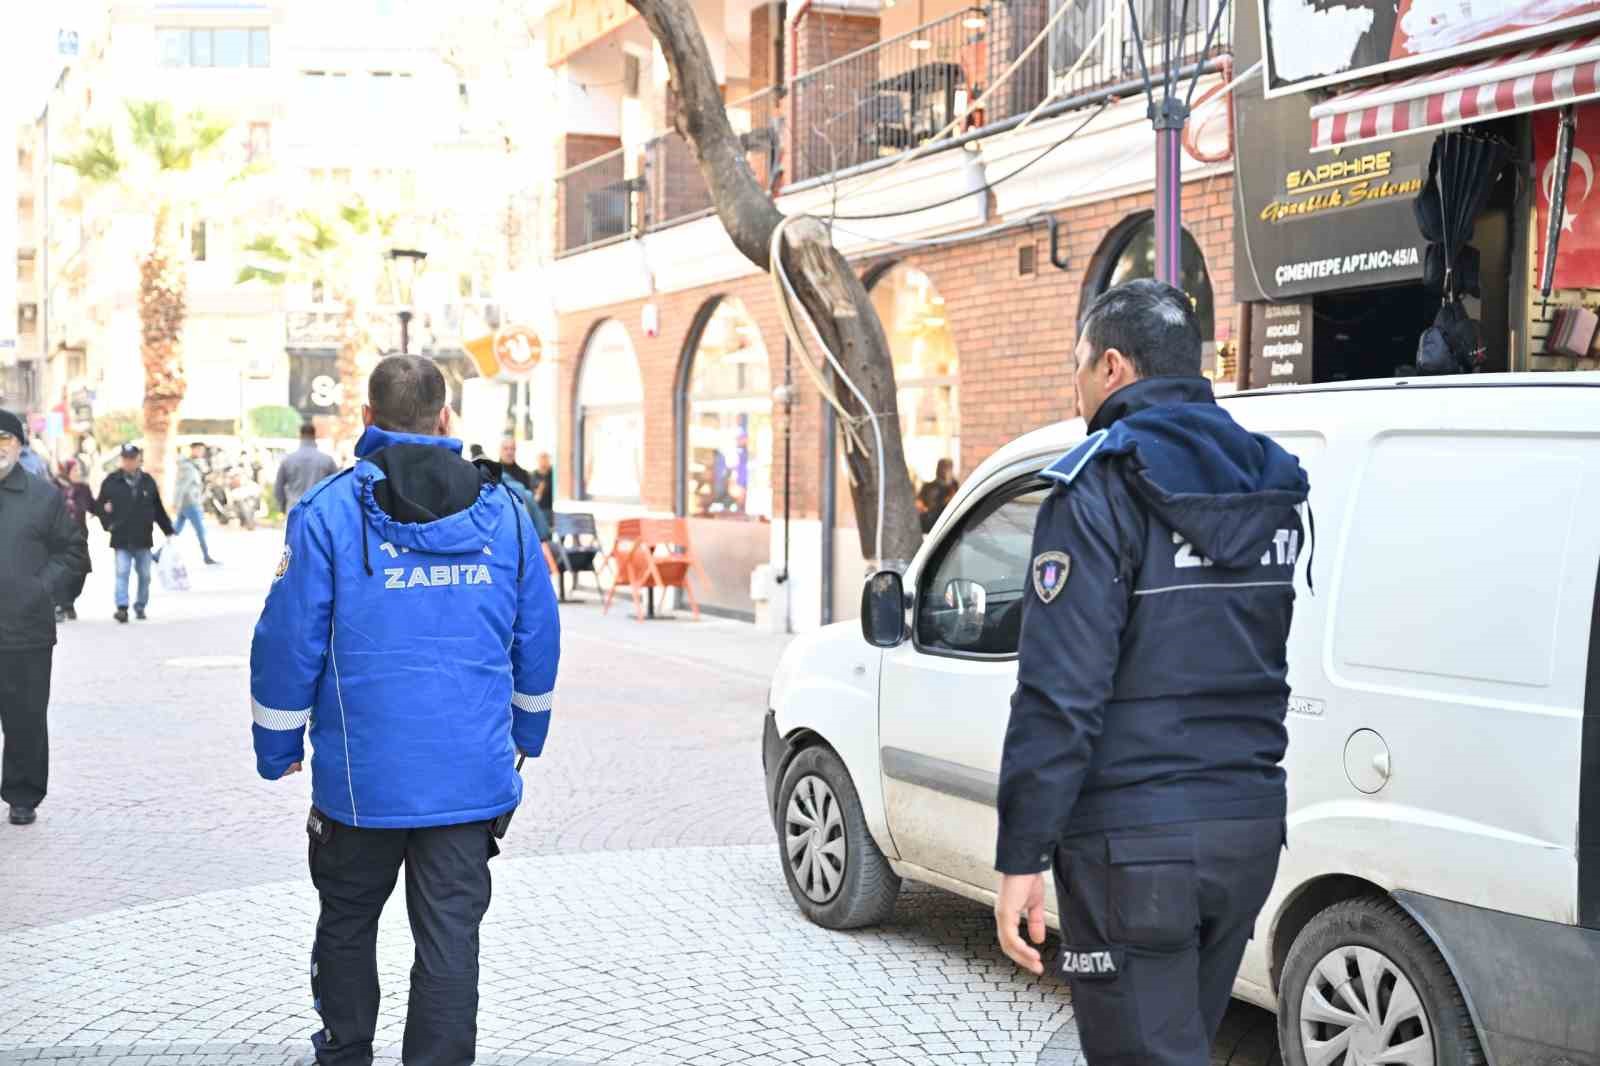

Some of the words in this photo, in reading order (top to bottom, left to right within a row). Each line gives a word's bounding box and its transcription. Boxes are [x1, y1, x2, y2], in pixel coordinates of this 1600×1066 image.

[1286, 150, 1392, 189] SAPPHIRE
[384, 564, 492, 589] ZABITA
[1062, 951, 1117, 973] ZABITA
